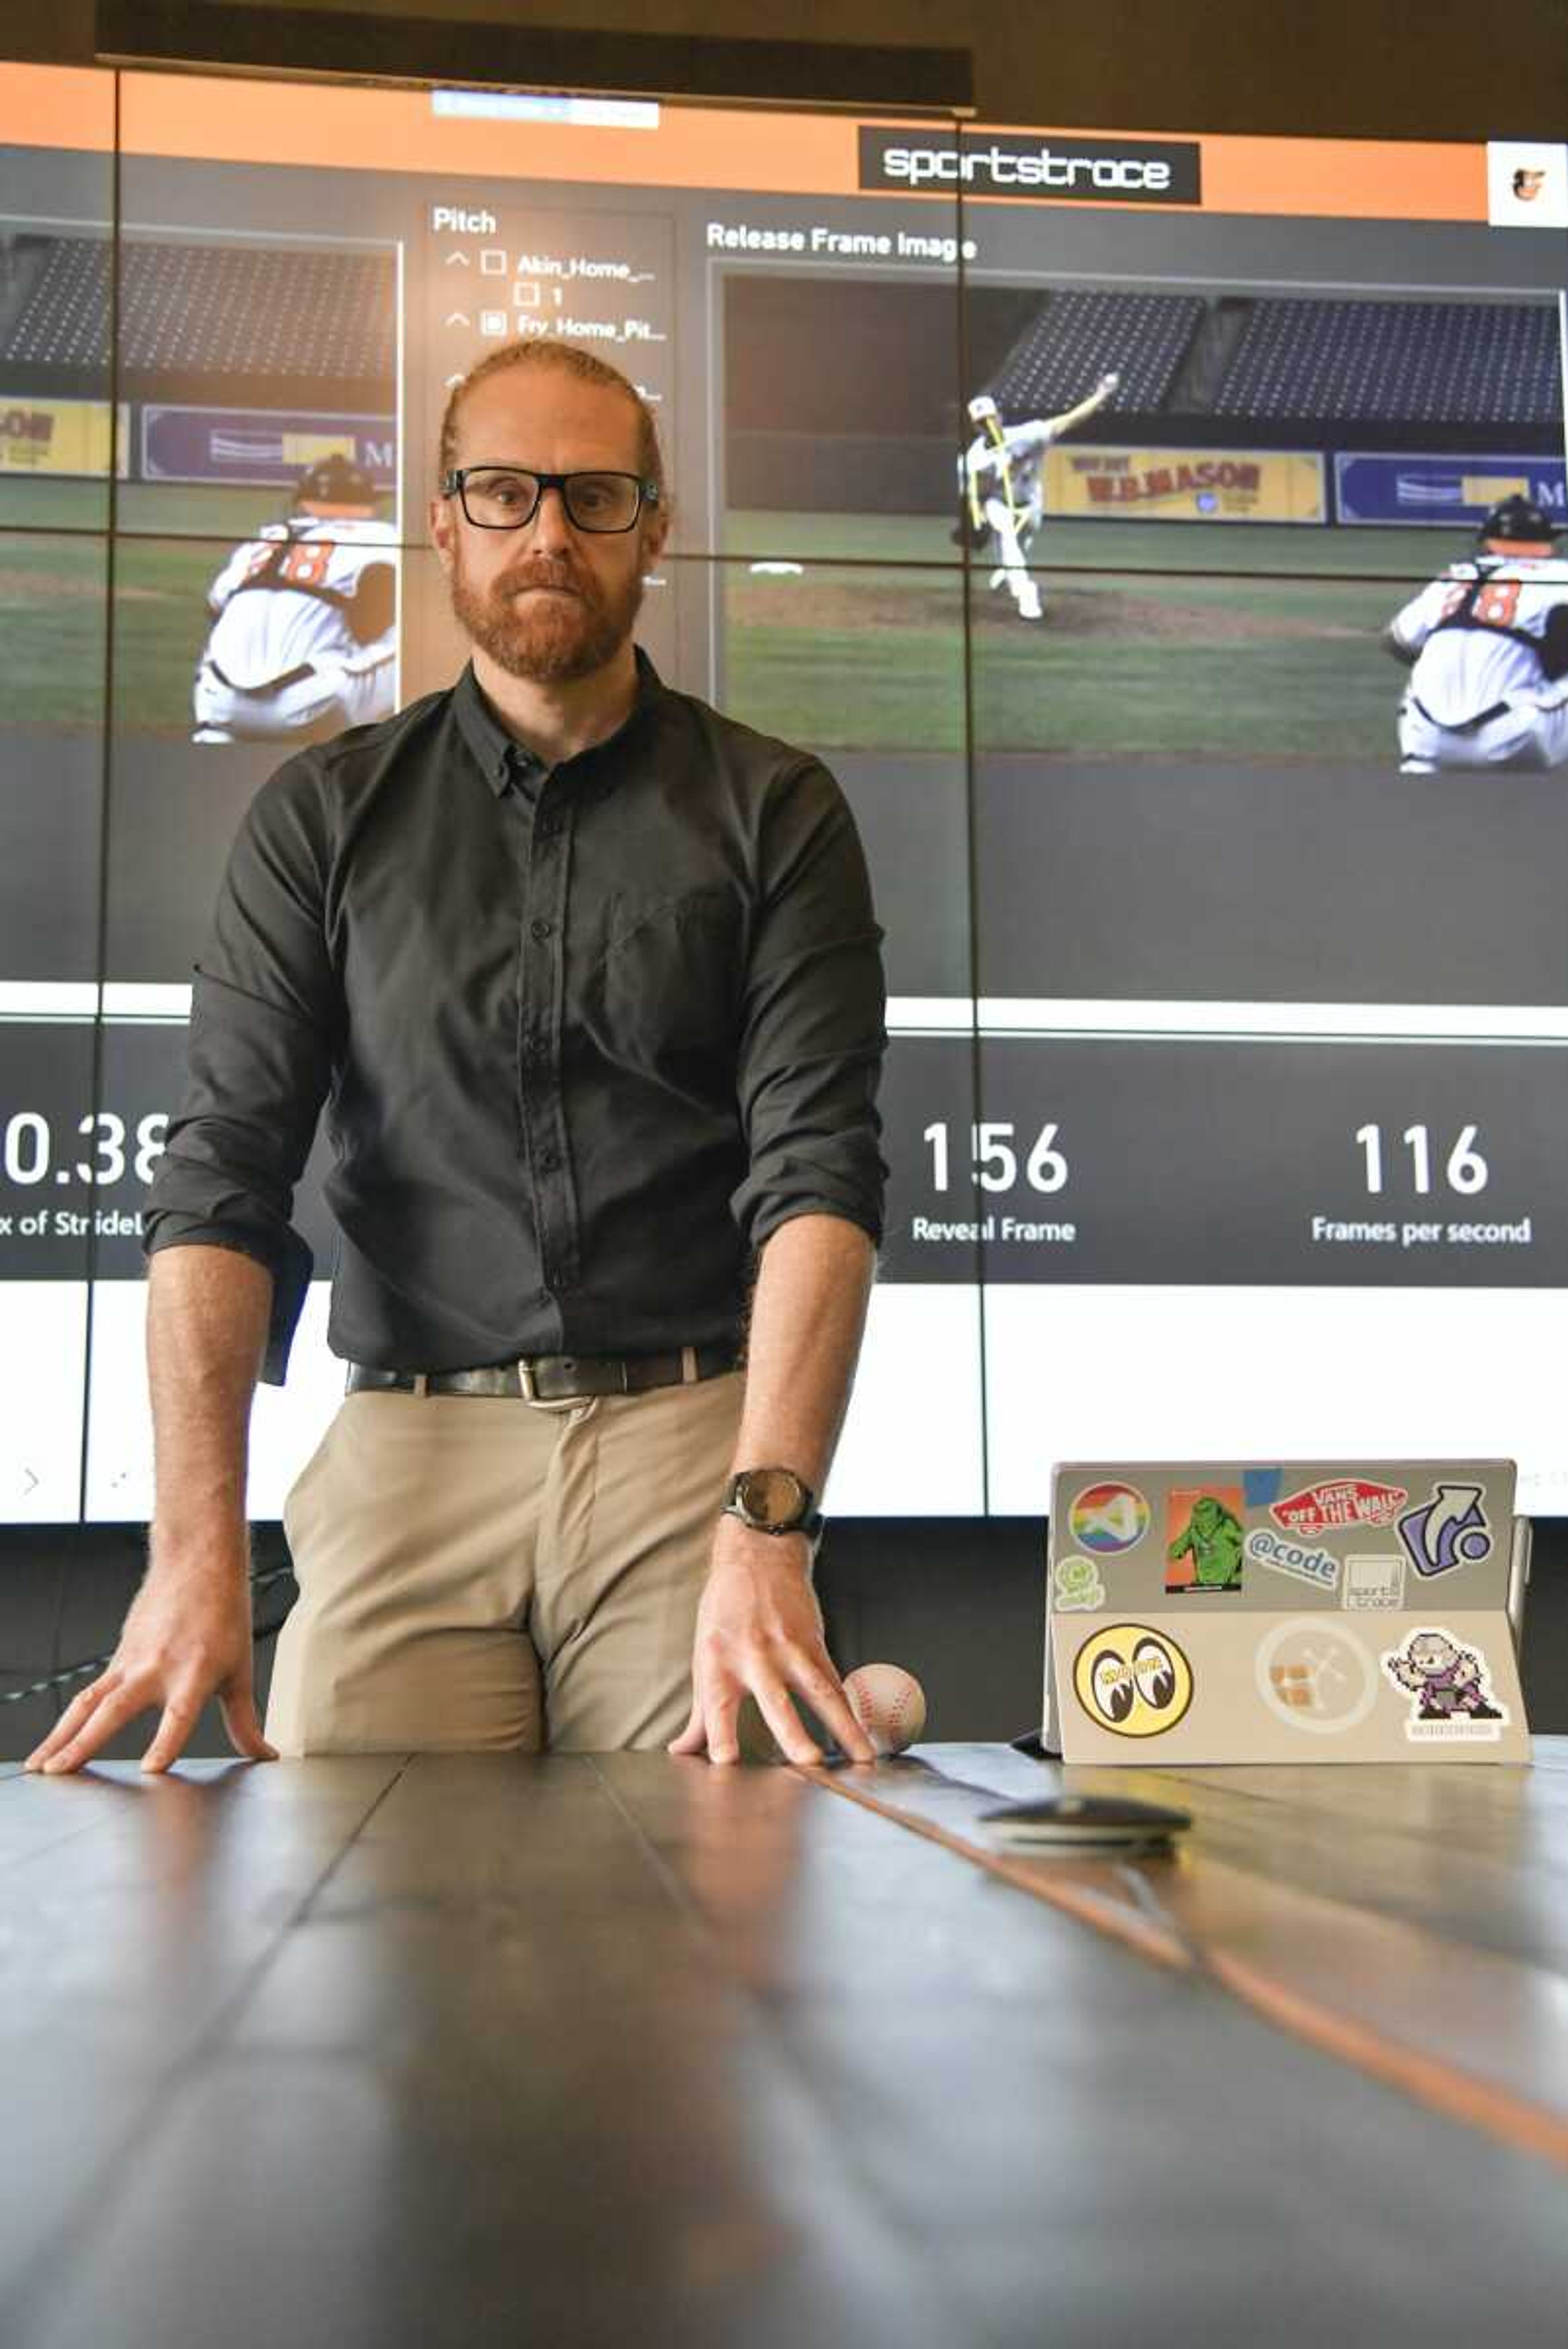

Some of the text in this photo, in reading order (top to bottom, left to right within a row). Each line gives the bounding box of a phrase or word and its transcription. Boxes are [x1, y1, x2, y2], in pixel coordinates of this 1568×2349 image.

[433, 207, 496, 234] Pitch
[707, 223, 977, 262] Release Frame Image
[924, 1122, 1069, 1193] 156
[1356, 1124, 1488, 1194] 116
[20, 1209, 49, 1236] of
[913, 1216, 1076, 1242] Reveal Frame
[1312, 1217, 1532, 1247] Frames per second
[1251, 1532, 1336, 1579] @code
